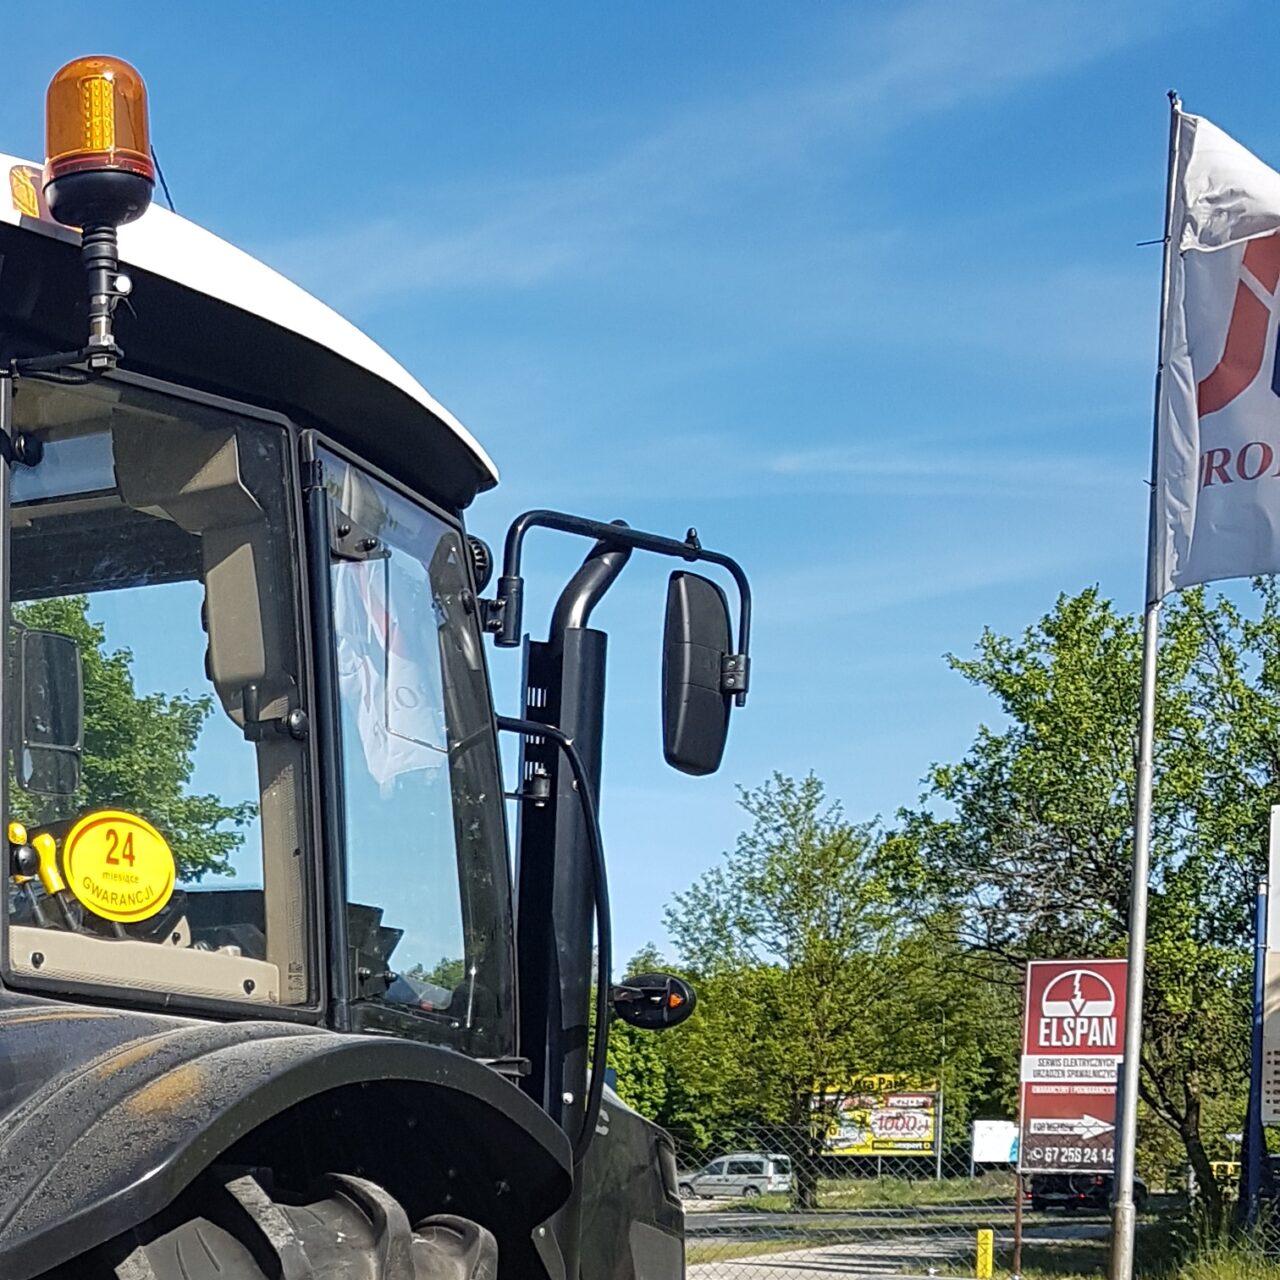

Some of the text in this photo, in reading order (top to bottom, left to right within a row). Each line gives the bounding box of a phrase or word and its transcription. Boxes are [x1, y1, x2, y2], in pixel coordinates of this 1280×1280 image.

[1198, 441, 1280, 495] RO
[105, 828, 136, 867] 24
[82, 876, 154, 907] GWARANCJI
[102, 871, 140, 885] miesiące
[1038, 1017, 1117, 1047] ELSPAN
[1037, 1058, 1062, 1067] SERWIS
